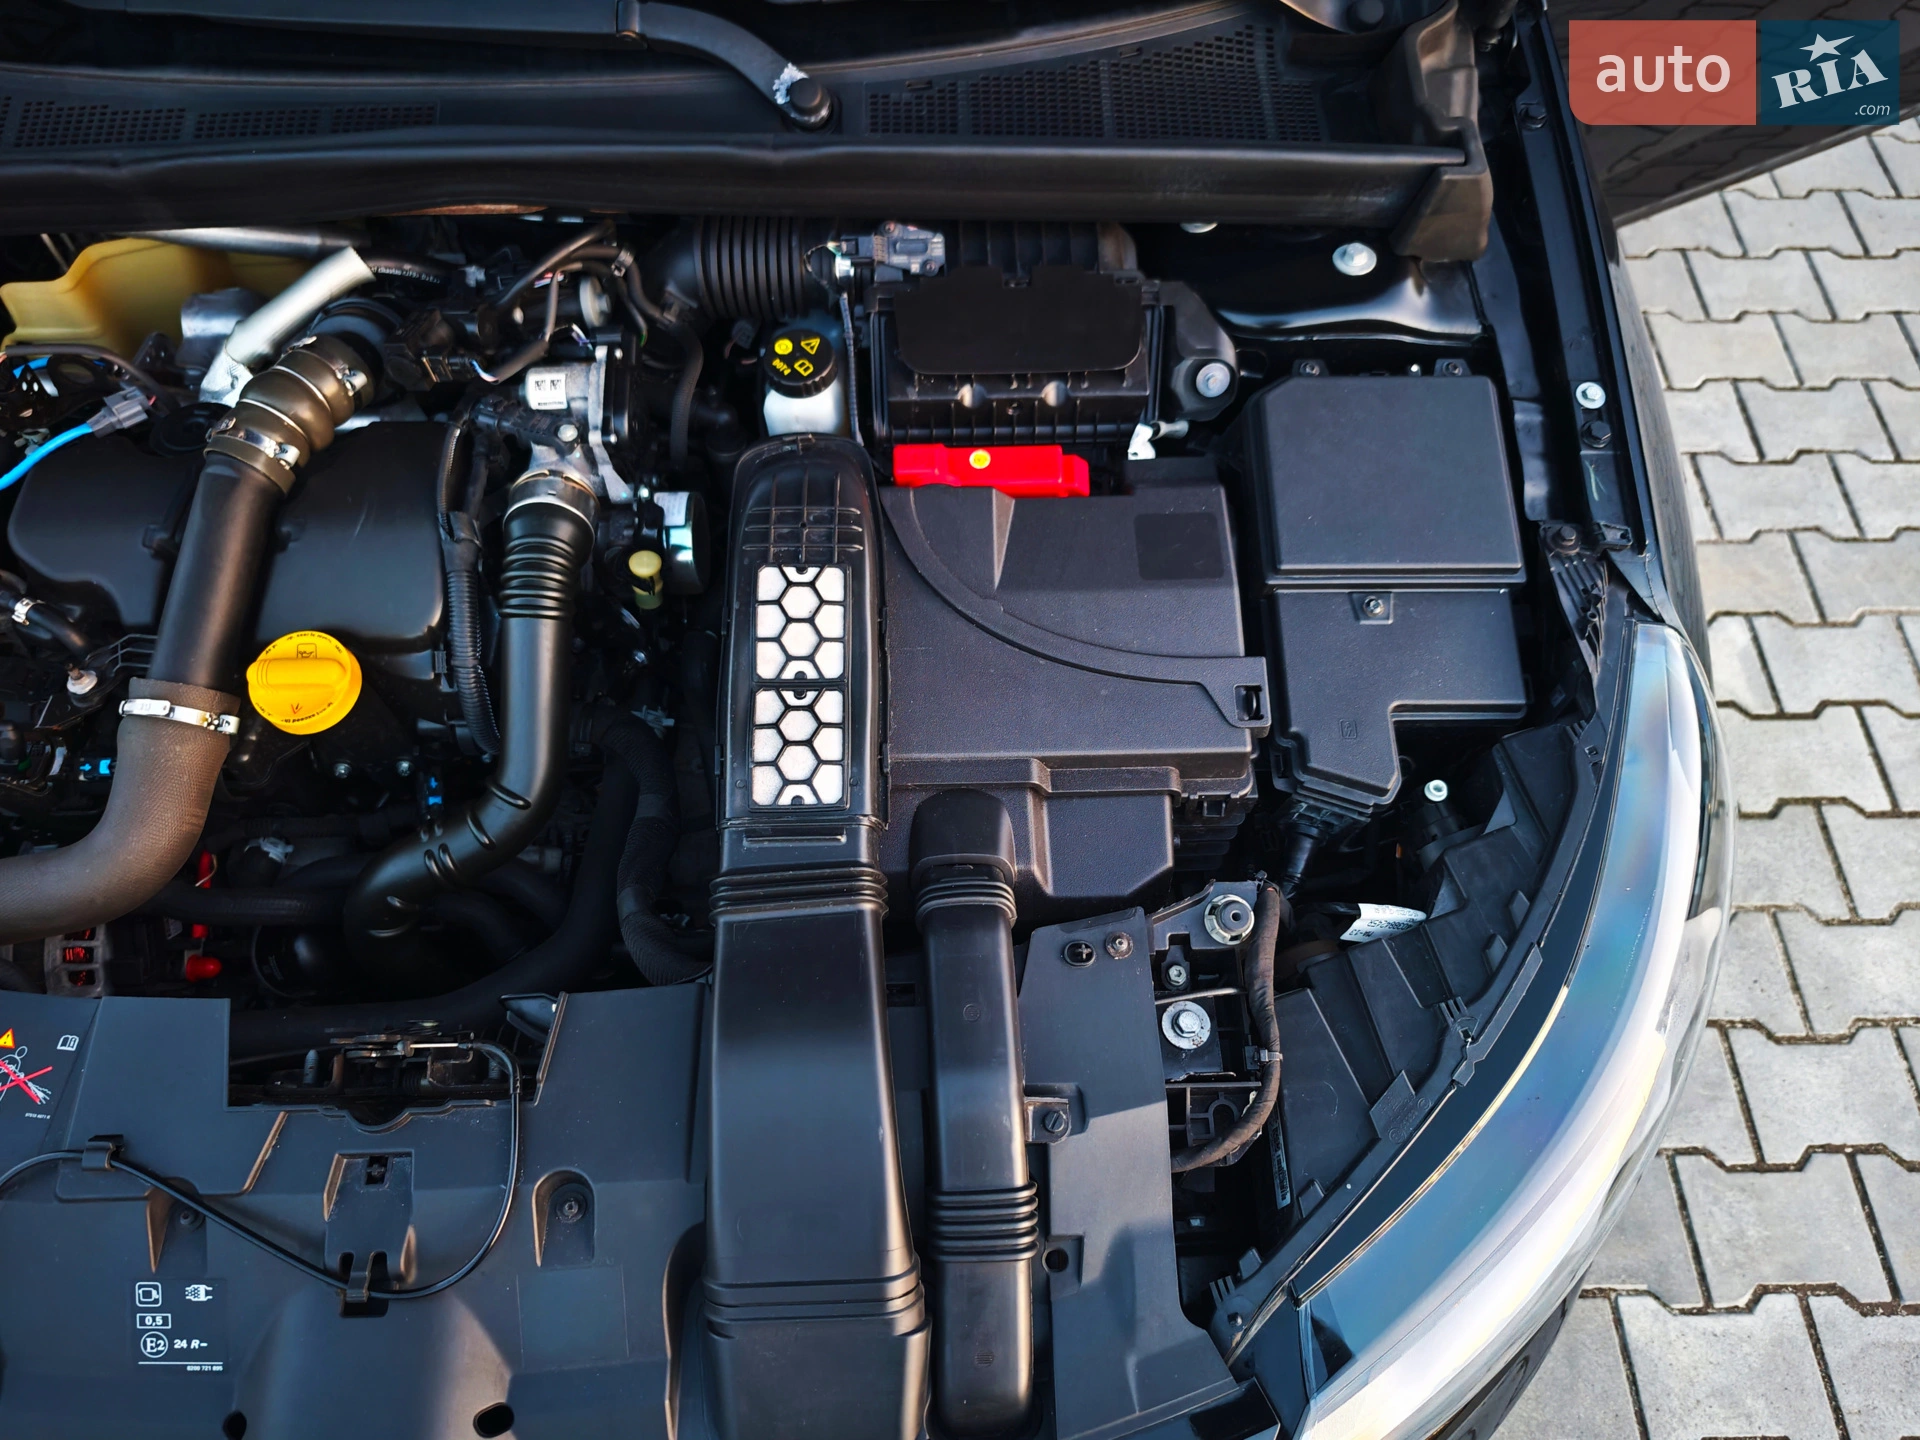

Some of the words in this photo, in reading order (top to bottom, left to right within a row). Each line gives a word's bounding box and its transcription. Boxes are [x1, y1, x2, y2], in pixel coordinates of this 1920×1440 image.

[145, 1316, 163, 1327] 0,5
[145, 1337, 165, 1353] E2
[173, 1339, 187, 1349] 24
